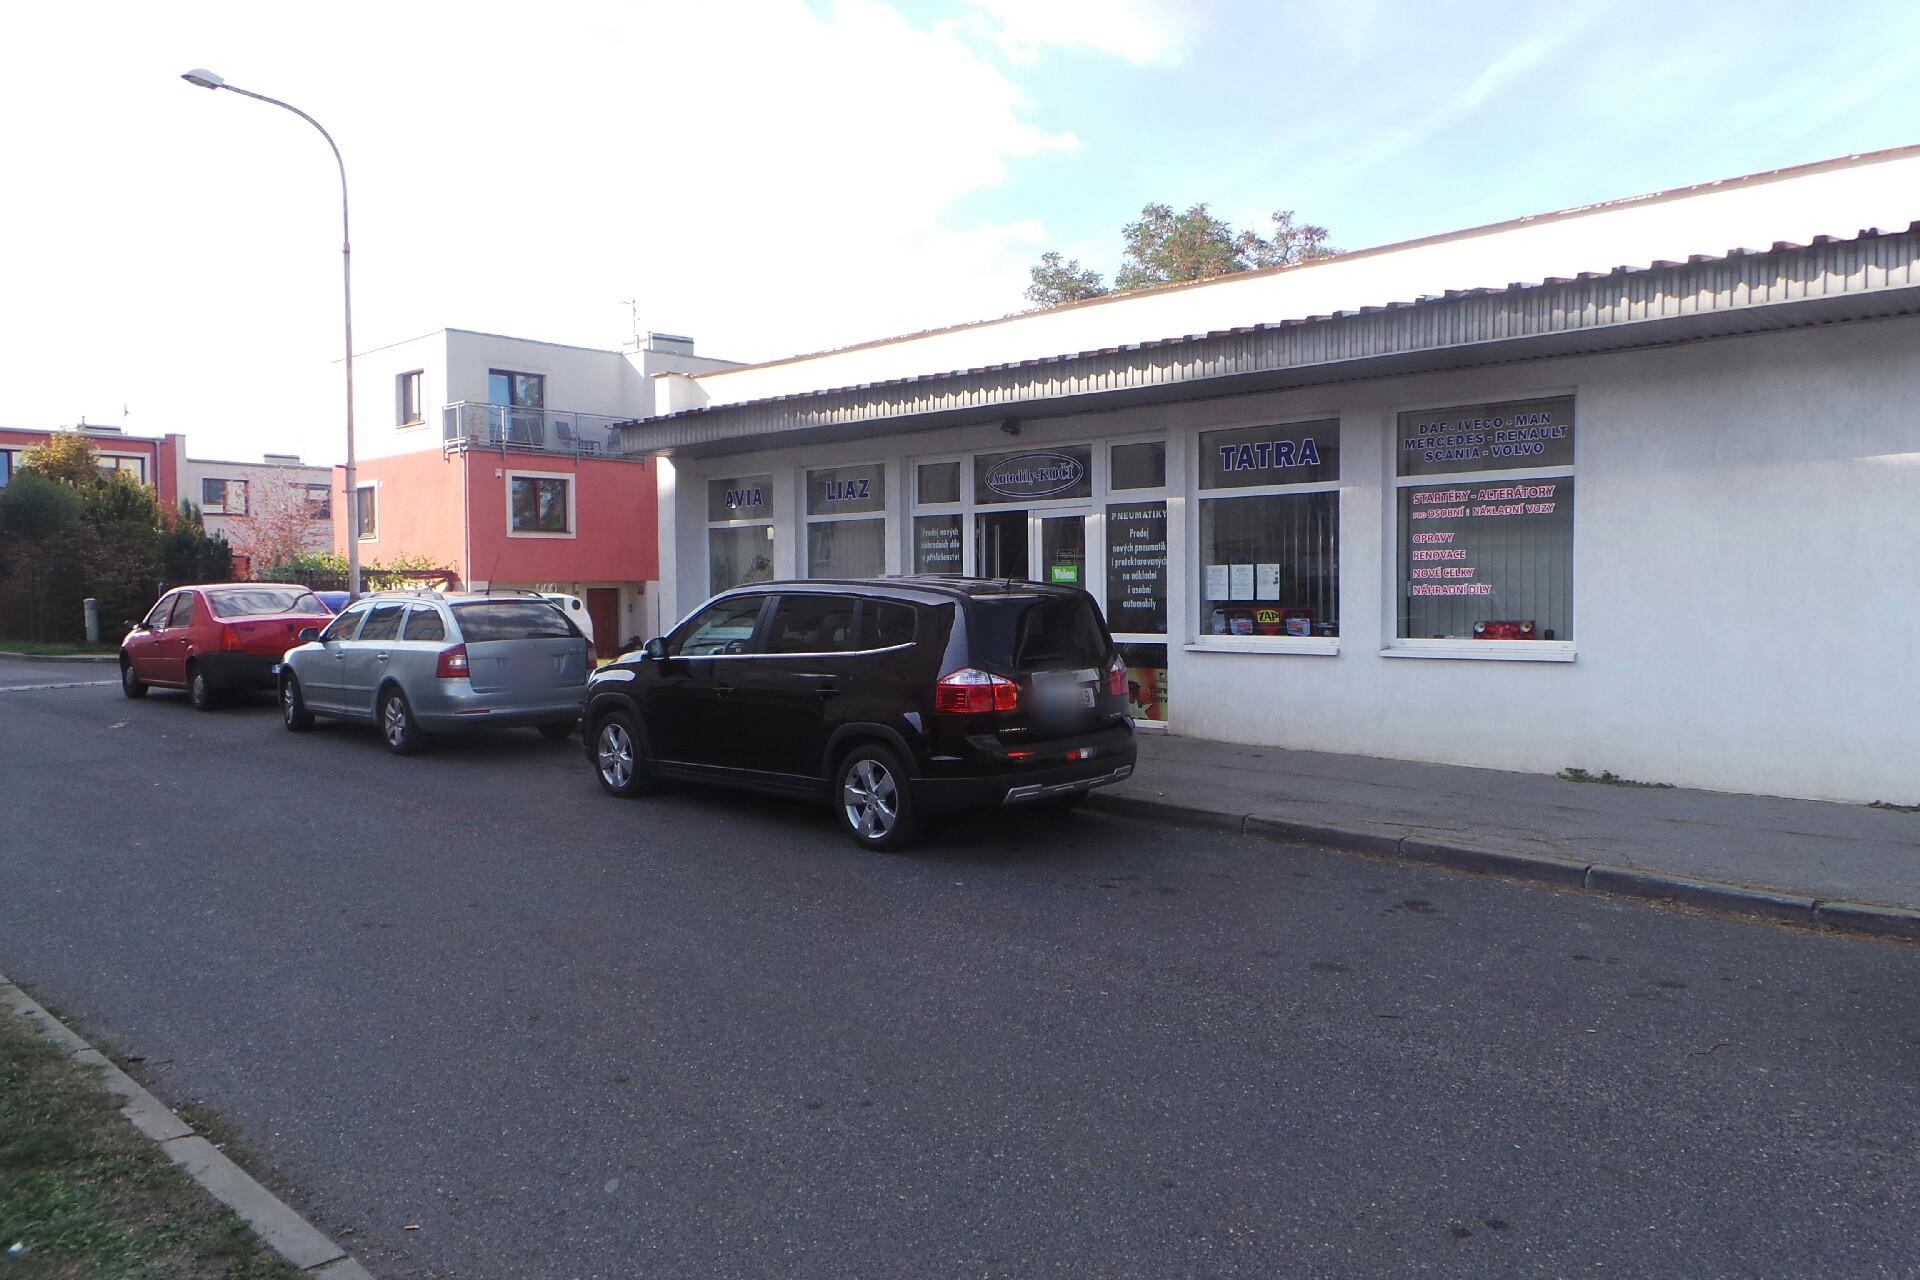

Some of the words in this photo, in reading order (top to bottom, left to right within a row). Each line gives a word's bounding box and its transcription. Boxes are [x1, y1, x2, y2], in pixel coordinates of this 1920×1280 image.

[1418, 421, 1448, 436] DAF
[1457, 416, 1505, 433] IVECO
[1515, 412, 1552, 427] MAN
[1404, 433, 1484, 451] MERCEDES
[1496, 425, 1569, 443] RENAULT
[1219, 438, 1321, 472] TATRA
[1423, 447, 1481, 463] SCANIA
[1492, 442, 1544, 457] VOLVO
[825, 479, 870, 502] LIAZ
[725, 487, 764, 508] AVIA
[1111, 509, 1167, 521] PNEUMATIKY
[1427, 506, 1466, 518] OSOBNÍ
[1472, 503, 1526, 517] NÁKLADNÍ
[1526, 503, 1556, 513] VOZY
[1129, 528, 1149, 540] Prodej
[1413, 532, 1455, 543] OPRAVY
[1112, 542, 1134, 555] nových
[1134, 541, 1167, 555] pneumatik
[1413, 549, 1466, 561] RENOVACE
[1413, 567, 1442, 579] NOVÉ
[1443, 567, 1475, 578] CELKY
[1413, 583, 1468, 596] NÁHRADNÍ
[1468, 583, 1492, 595] DÍLY
[1122, 598, 1157, 610] automobily
[1258, 610, 1280, 622] ZAP
